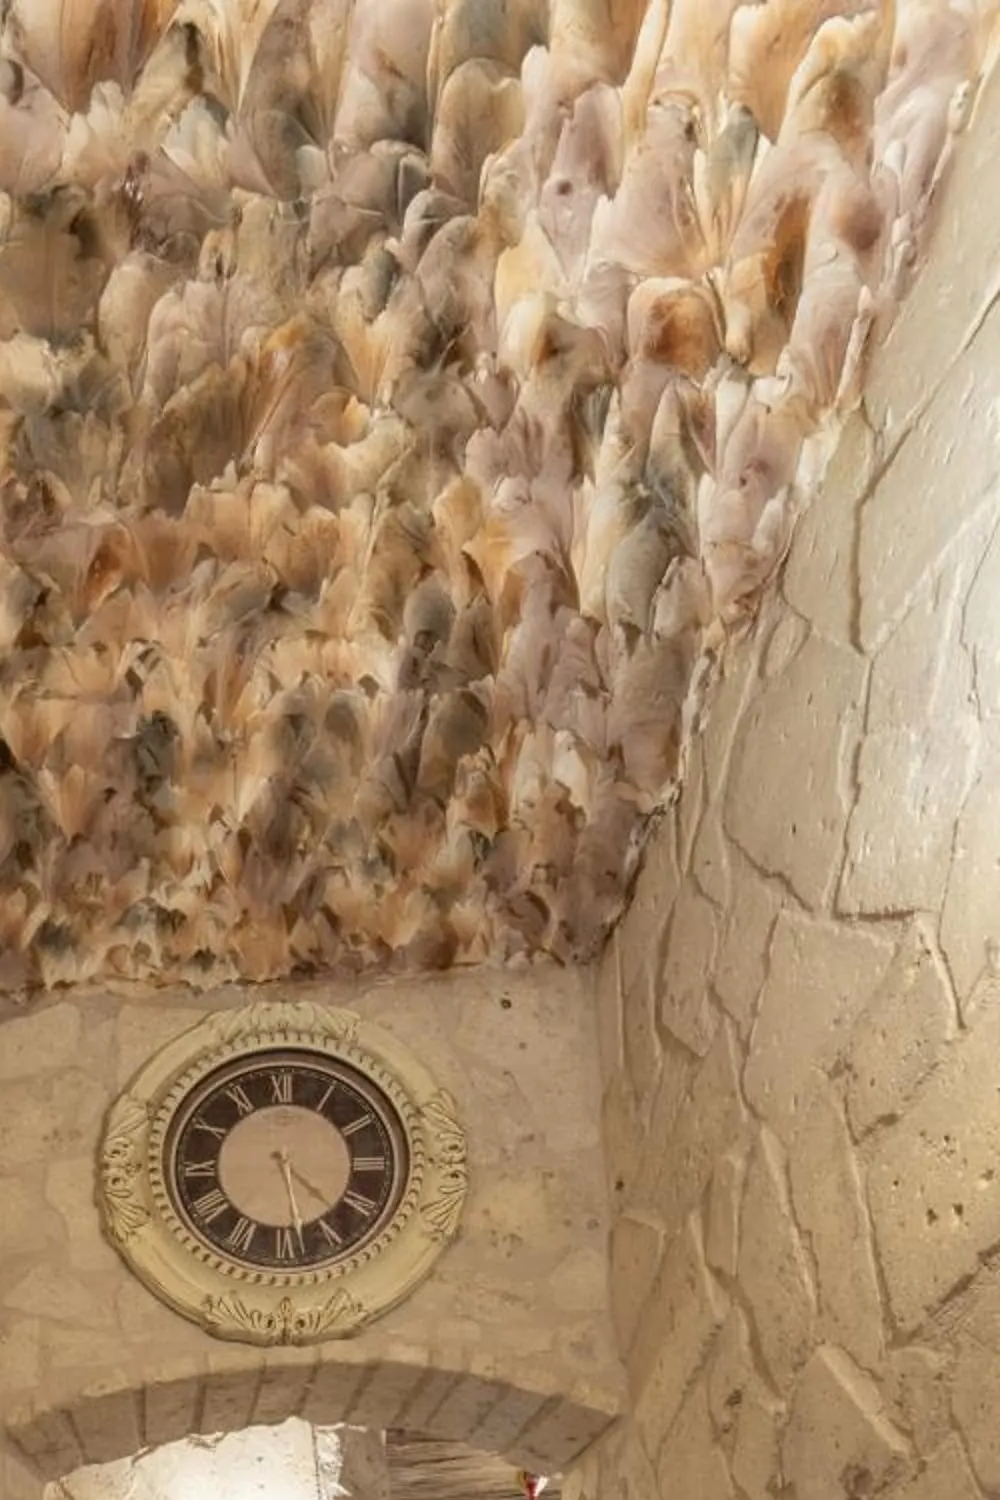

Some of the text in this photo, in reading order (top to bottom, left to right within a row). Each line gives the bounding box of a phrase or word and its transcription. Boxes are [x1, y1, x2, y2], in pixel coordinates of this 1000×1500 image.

[271, 1075, 293, 1103] XII
[315, 1080, 338, 1112] I
[341, 1112, 375, 1137] II
[353, 1157, 385, 1171] III
